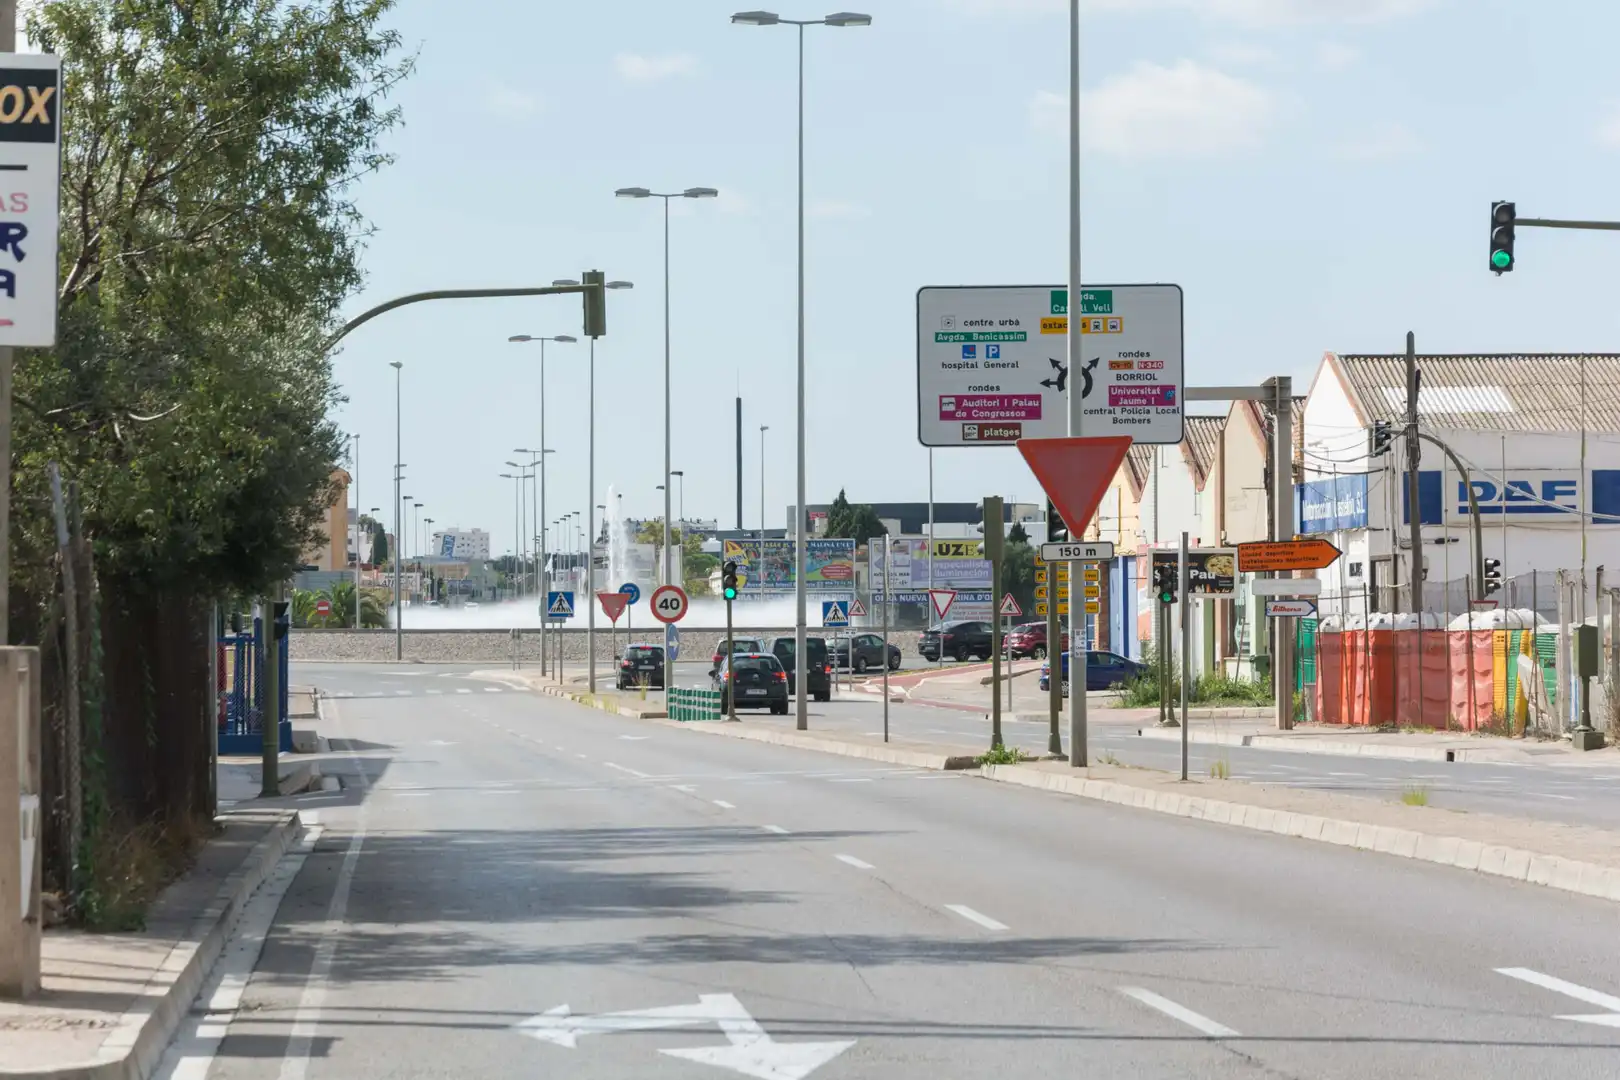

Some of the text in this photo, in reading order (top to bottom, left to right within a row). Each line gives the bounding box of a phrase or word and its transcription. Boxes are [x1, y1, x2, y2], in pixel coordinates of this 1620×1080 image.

[1093, 303, 1111, 312] Vell
[1042, 320, 1087, 329] estacs
[937, 334, 968, 342] Avgda.
[1118, 350, 1150, 358] rondes
[942, 360, 1019, 370] hospital General
[1116, 373, 1158, 382] BORRIOL
[968, 384, 1000, 392] rondes
[1111, 386, 1160, 395] Universitat
[962, 398, 1000, 408] Auditori
[1012, 398, 1040, 407] Palau
[1118, 397, 1148, 405] Jaume
[1084, 407, 1116, 415] central
[1112, 416, 1152, 424] Bombers
[984, 428, 1020, 438] platges
[1458, 481, 1576, 501] DAF
[1059, 547, 1080, 556] 150
[659, 598, 680, 610] 40
